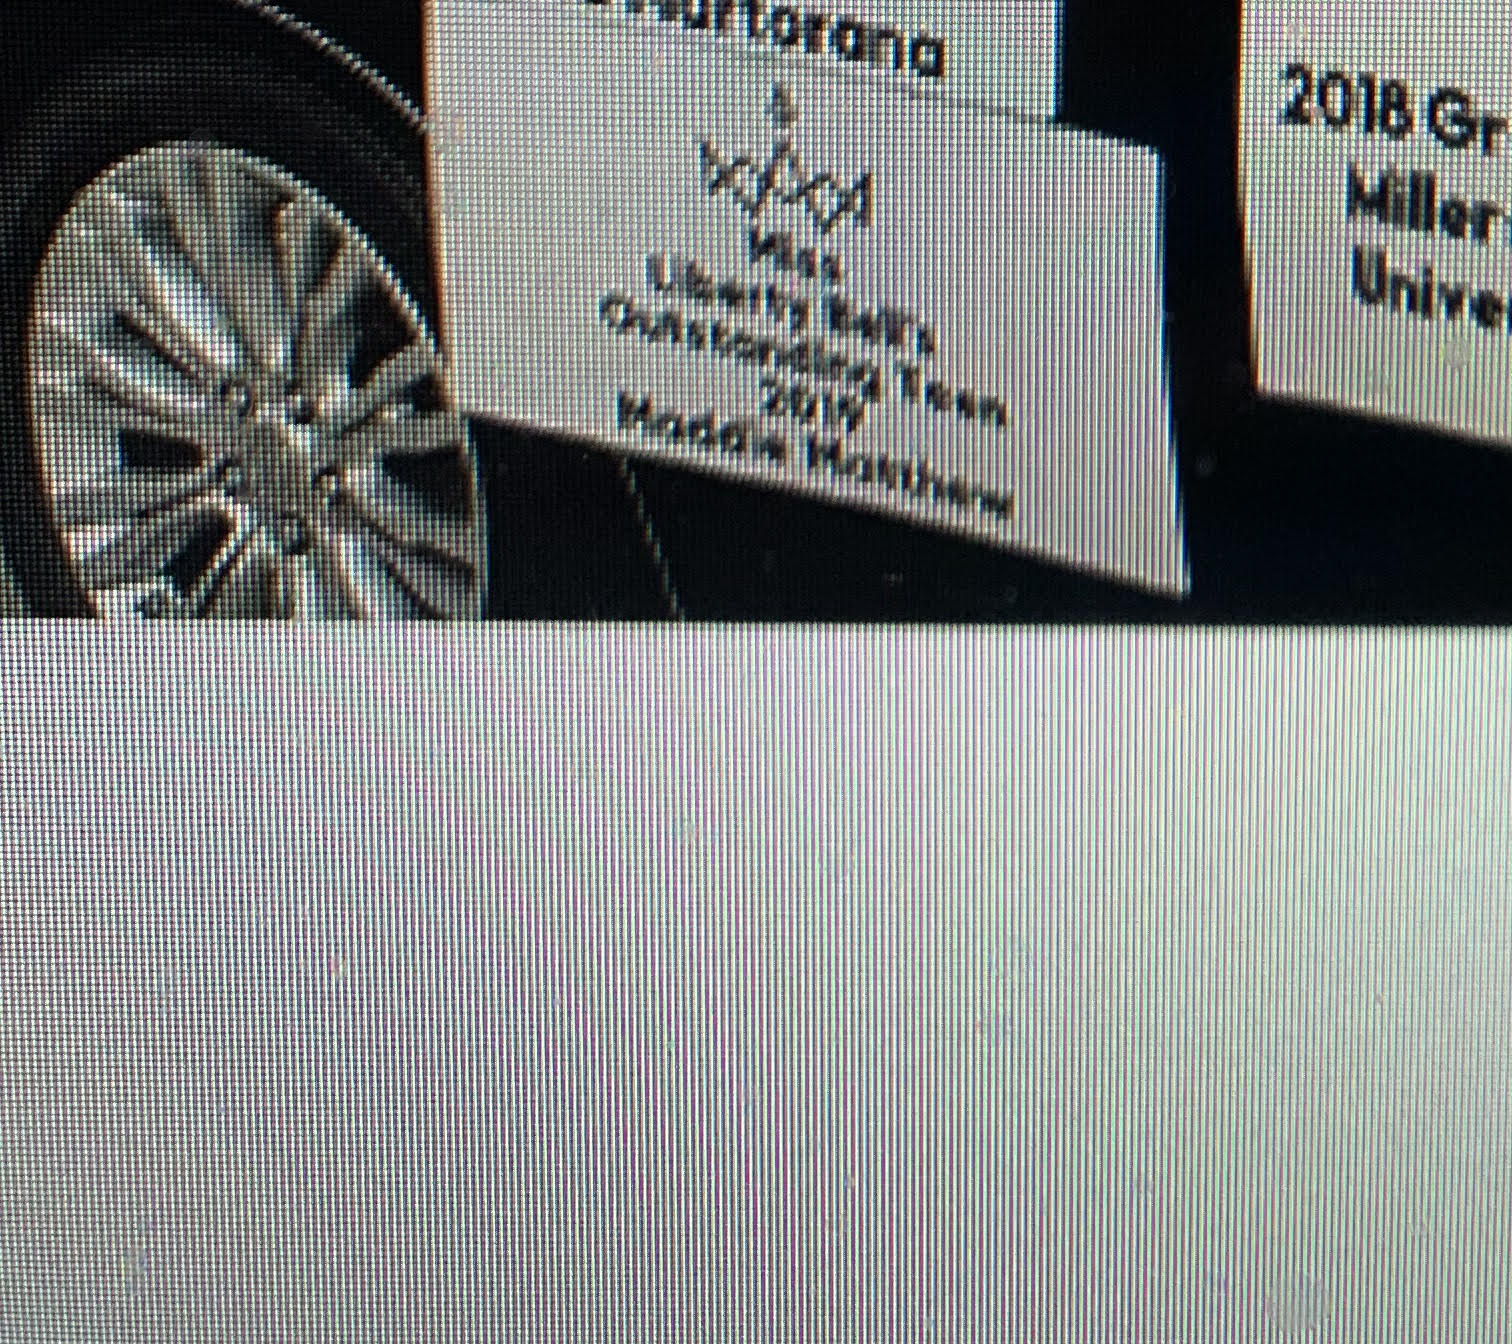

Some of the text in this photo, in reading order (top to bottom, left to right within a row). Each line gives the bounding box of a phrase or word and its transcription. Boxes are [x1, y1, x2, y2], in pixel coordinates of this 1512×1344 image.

[1278, 58, 1414, 141] 2018
[647, 253, 809, 332] Liberty
[747, 225, 843, 283] Miss
[600, 291, 1009, 430] Outstanding Teen
[760, 373, 865, 434] 2019
